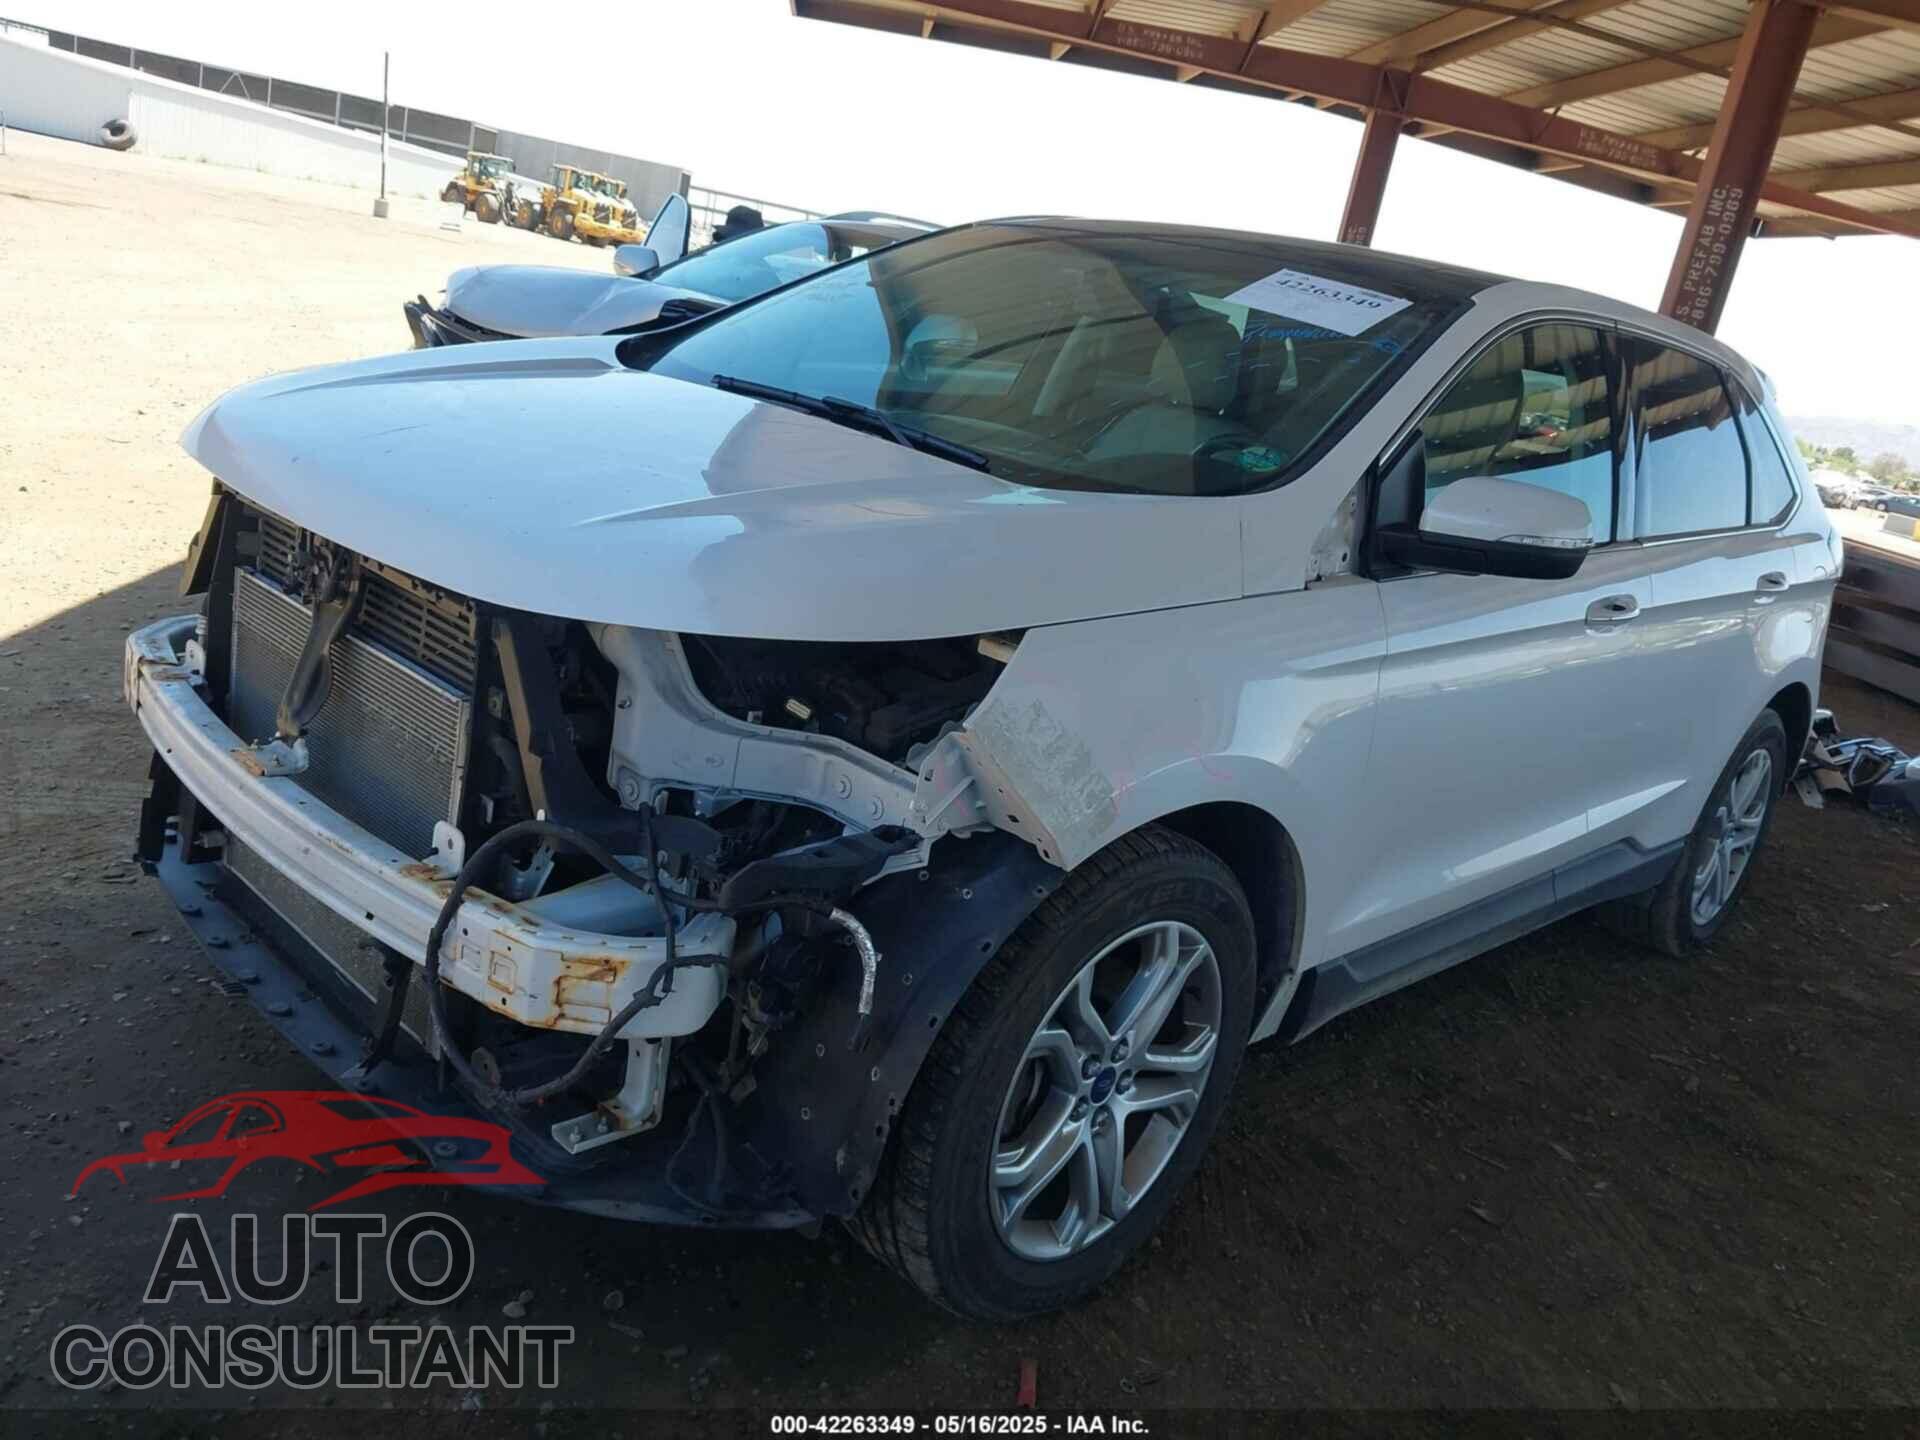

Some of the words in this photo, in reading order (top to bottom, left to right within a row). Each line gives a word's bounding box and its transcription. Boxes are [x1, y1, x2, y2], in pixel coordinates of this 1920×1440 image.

[1683, 224, 1715, 292] PREFAB
[1706, 184, 1731, 218] INC.
[1691, 187, 1744, 326] -866-799-0969
